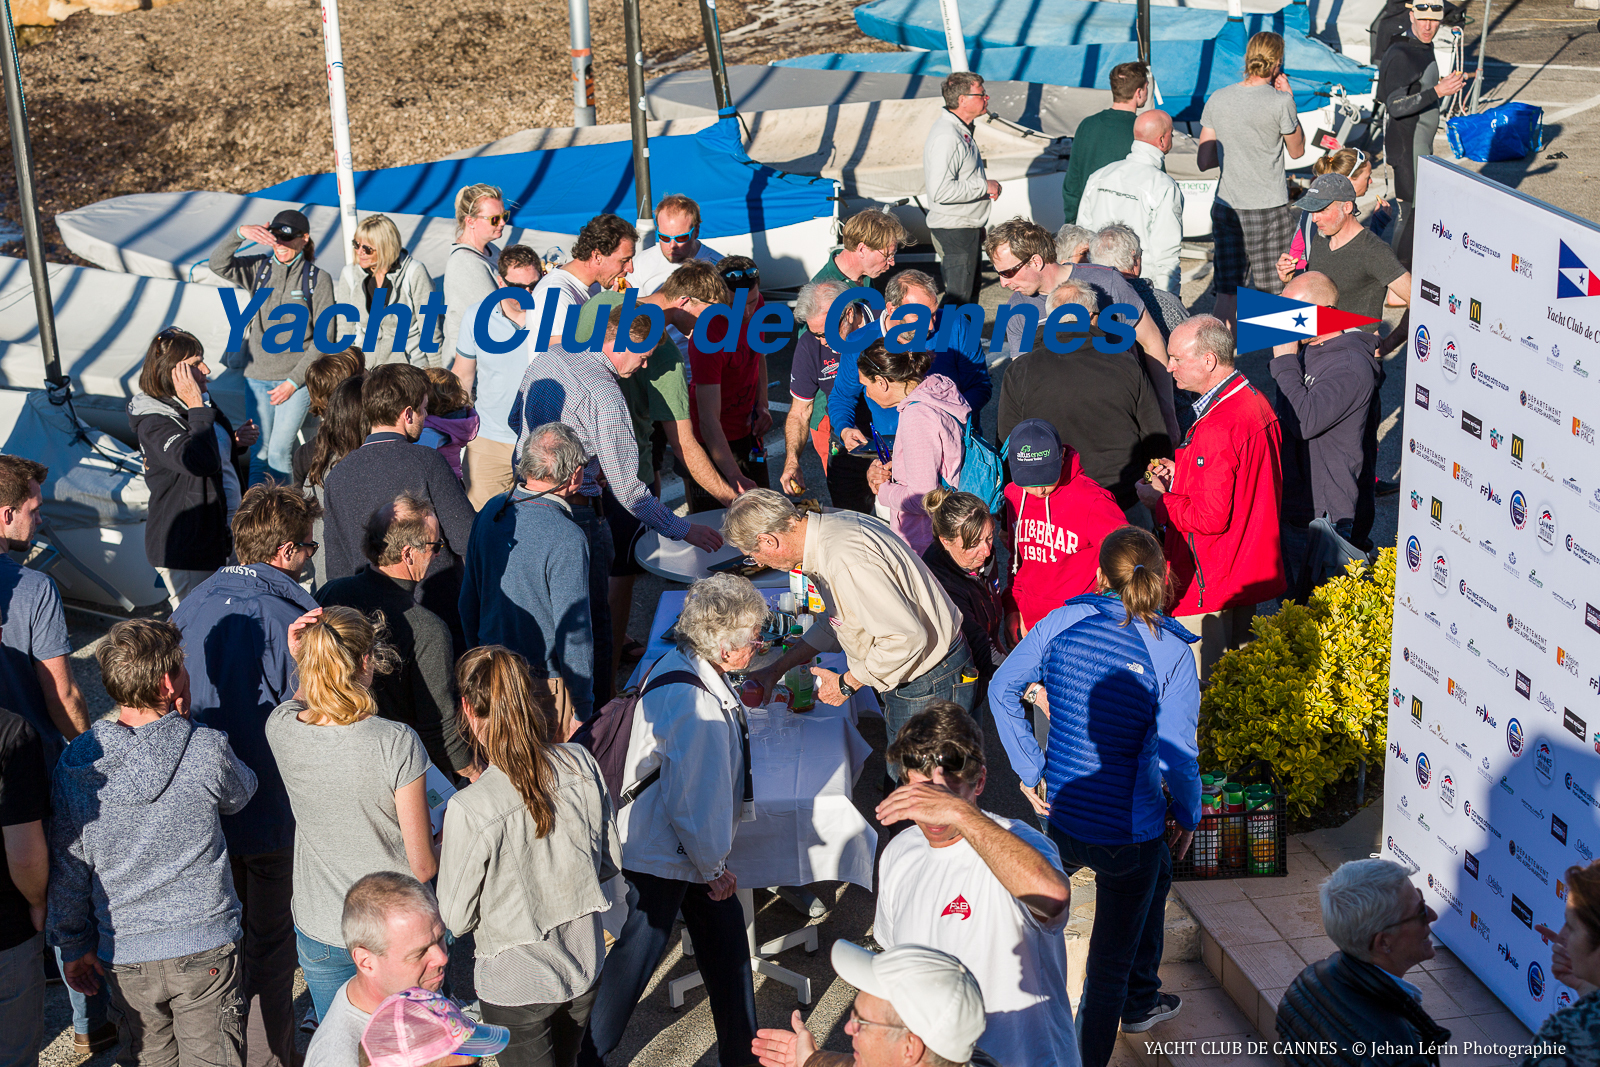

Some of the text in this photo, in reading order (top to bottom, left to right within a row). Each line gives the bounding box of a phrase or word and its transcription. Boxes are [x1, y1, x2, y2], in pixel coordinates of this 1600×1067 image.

[1547, 306, 1566, 327] Yacht
[1566, 316, 1584, 336] Club
[1584, 326, 1593, 340] de
[1030, 449, 1050, 458] energy
[1024, 545, 1047, 563] 1991
[221, 566, 257, 578] MUSTO
